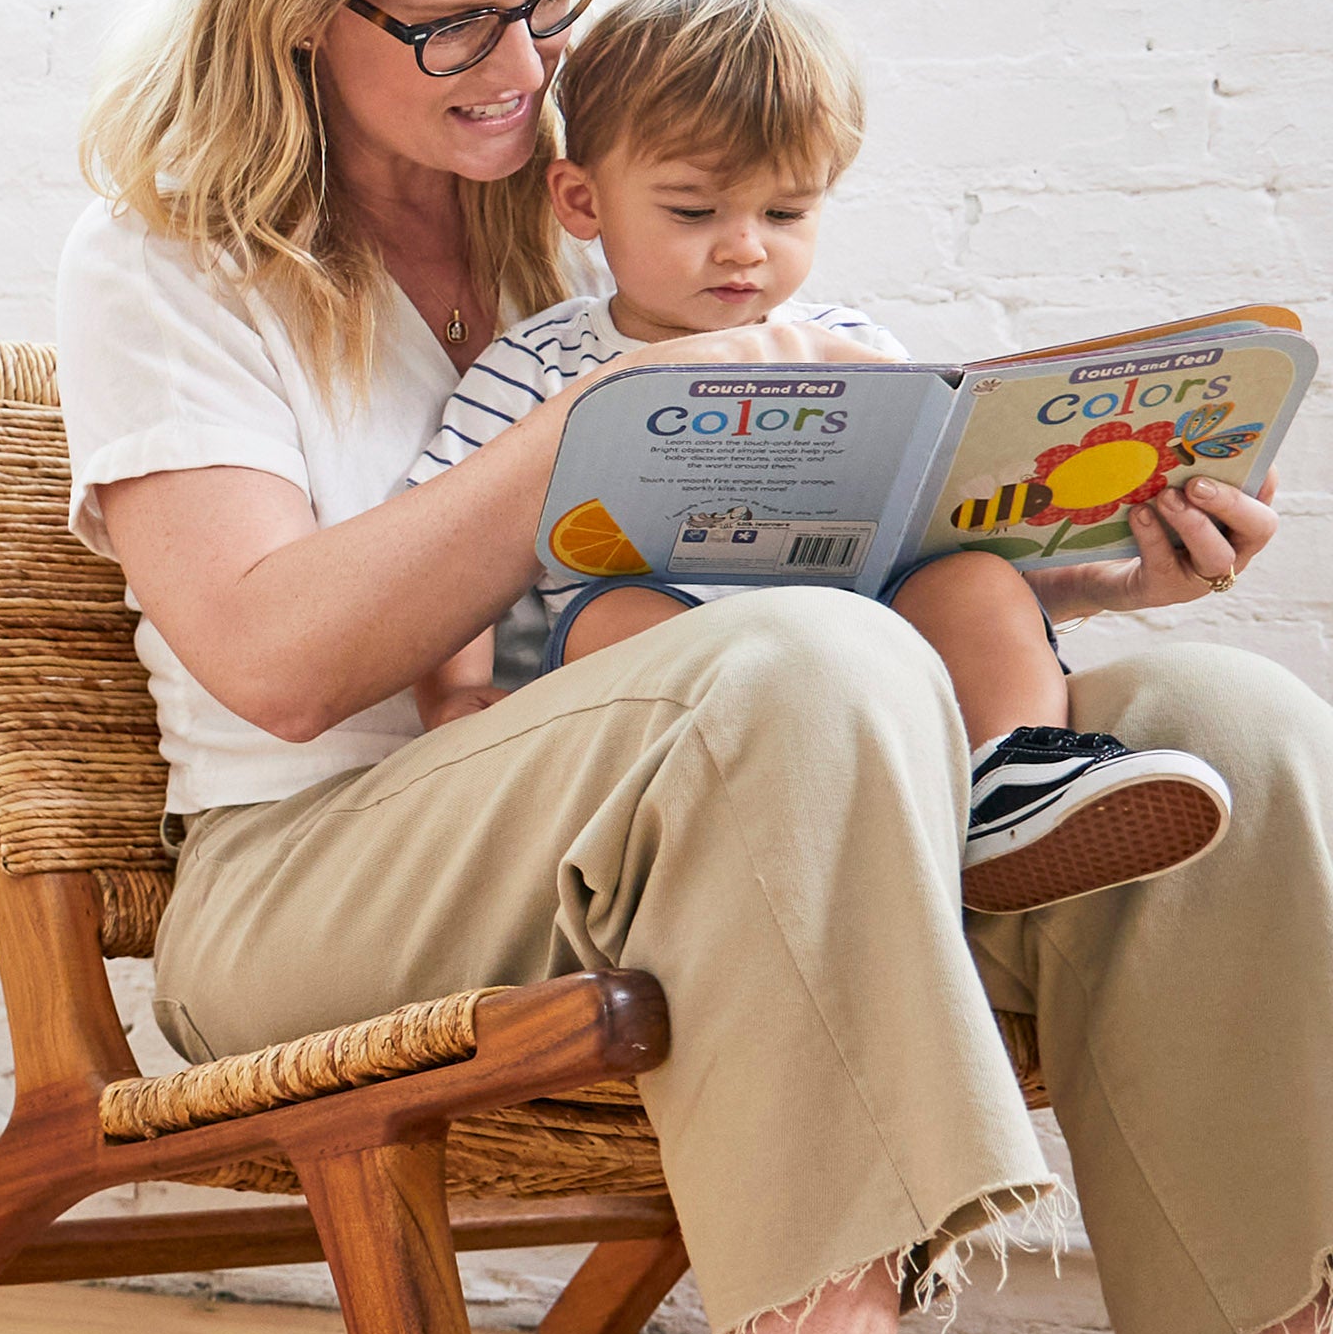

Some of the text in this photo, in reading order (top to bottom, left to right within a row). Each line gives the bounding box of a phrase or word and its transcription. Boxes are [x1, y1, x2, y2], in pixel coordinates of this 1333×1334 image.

[1077, 350, 1216, 381] touch and feel
[697, 383, 838, 395] touch and feel
